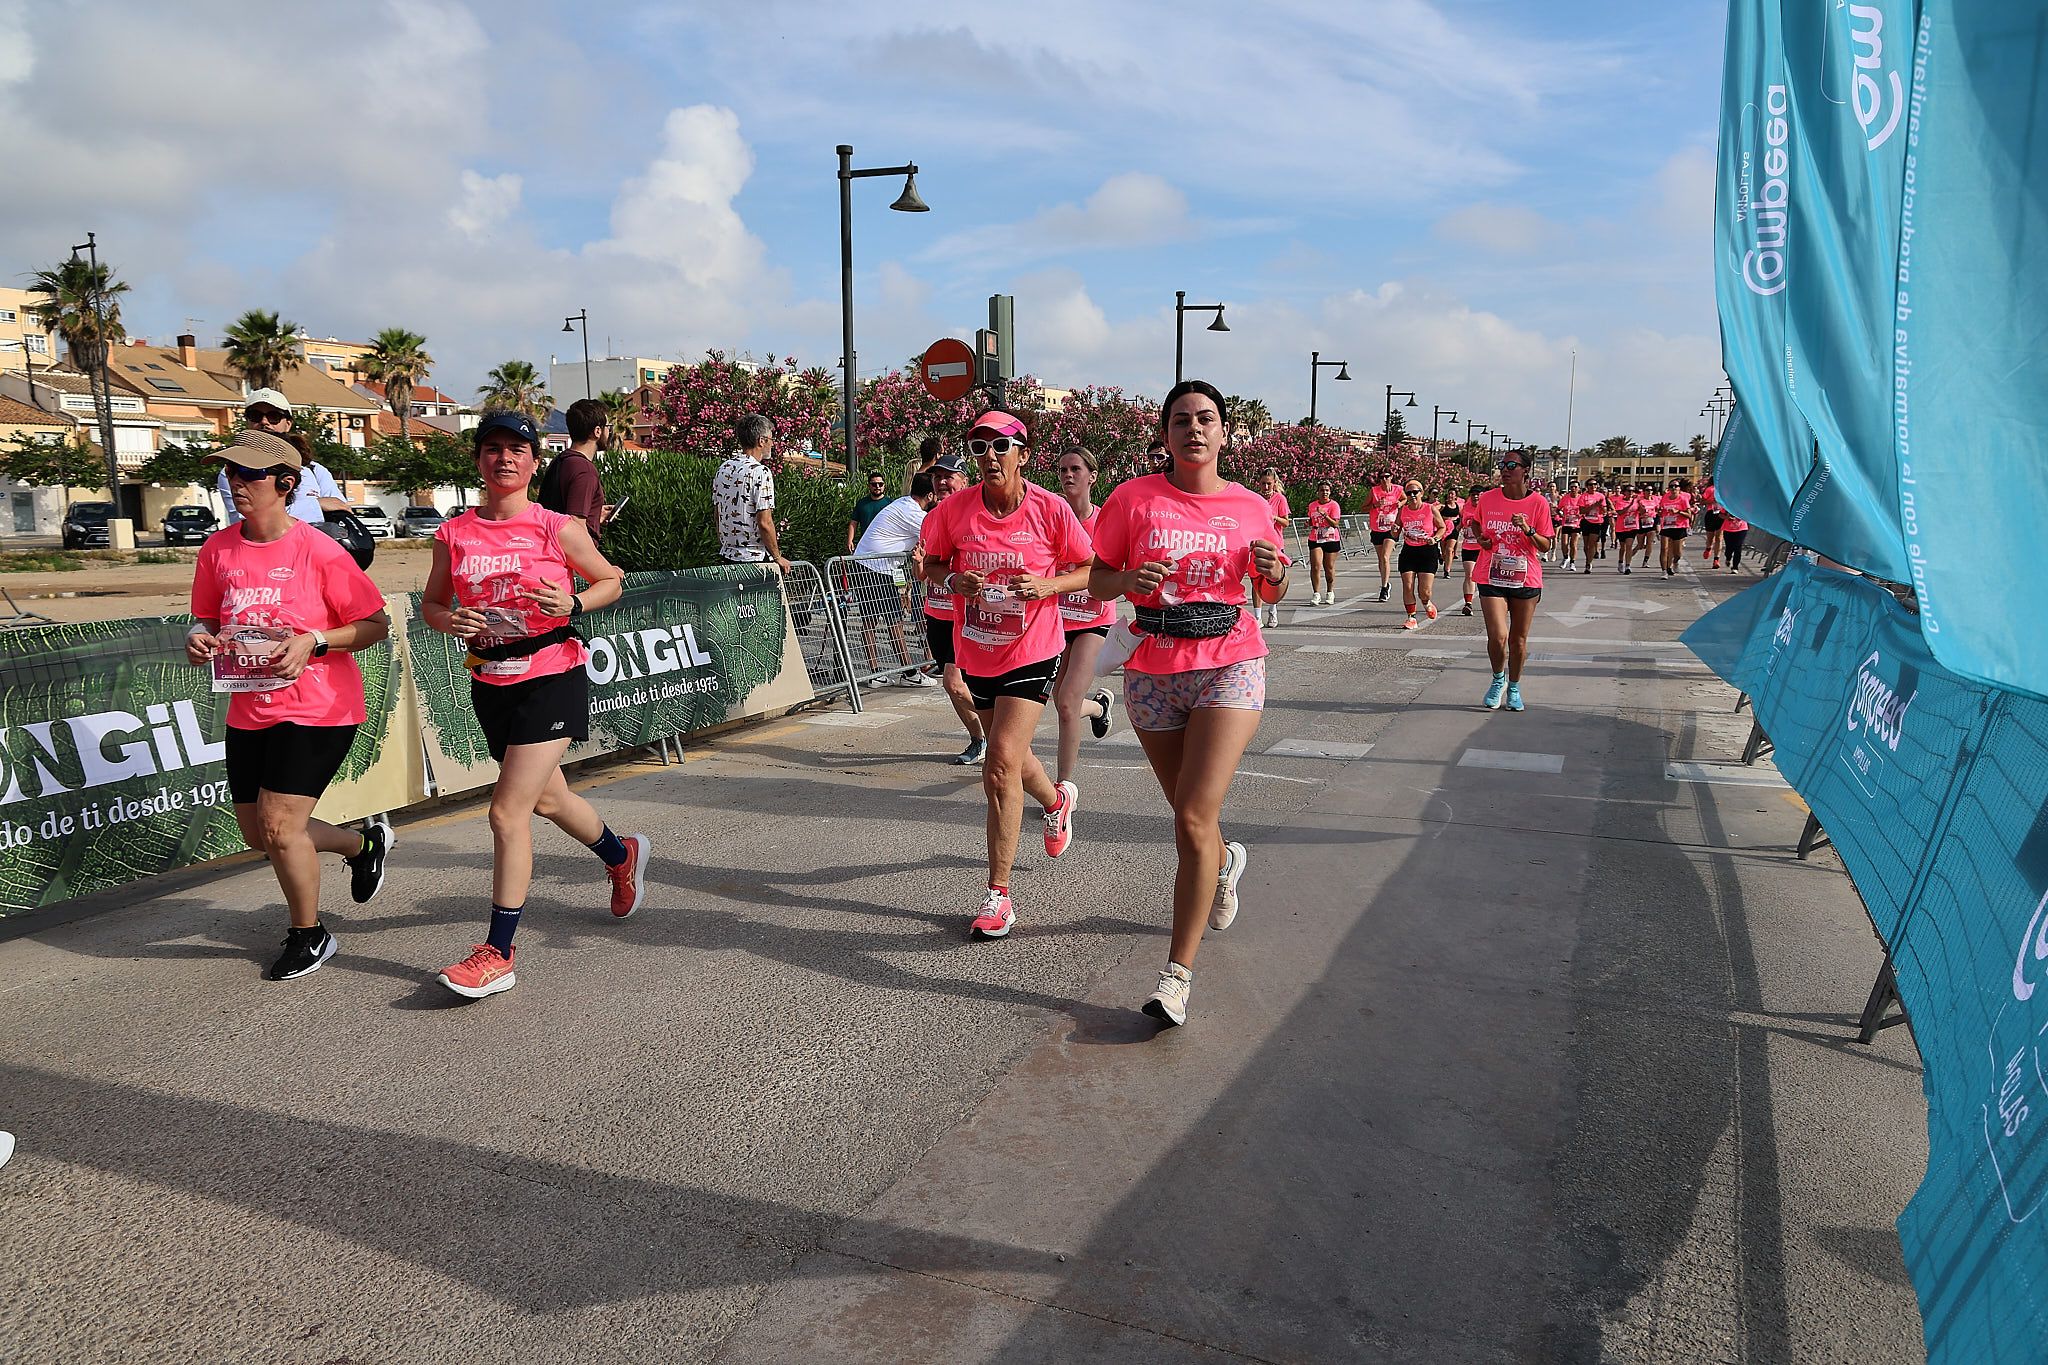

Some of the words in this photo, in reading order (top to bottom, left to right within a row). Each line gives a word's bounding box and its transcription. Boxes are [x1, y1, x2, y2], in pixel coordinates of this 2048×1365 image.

[1146, 510, 1181, 520] OYSHO
[1148, 528, 1227, 555] CARRERA
[933, 587, 948, 595] 016
[1068, 594, 1088, 604] 016
[737, 604, 756, 619] 2026
[980, 611, 1003, 624] 016
[238, 655, 270, 667] 016
[588, 692, 631, 715] dando
[632, 688, 648, 706] de
[649, 684, 660, 703] ti
[661, 677, 694, 699] desde
[695, 675, 719, 694] 1975
[40, 811, 75, 841] de
[80, 802, 104, 830] ti
[108, 787, 184, 824] desde
[189, 780, 233, 807] 197
